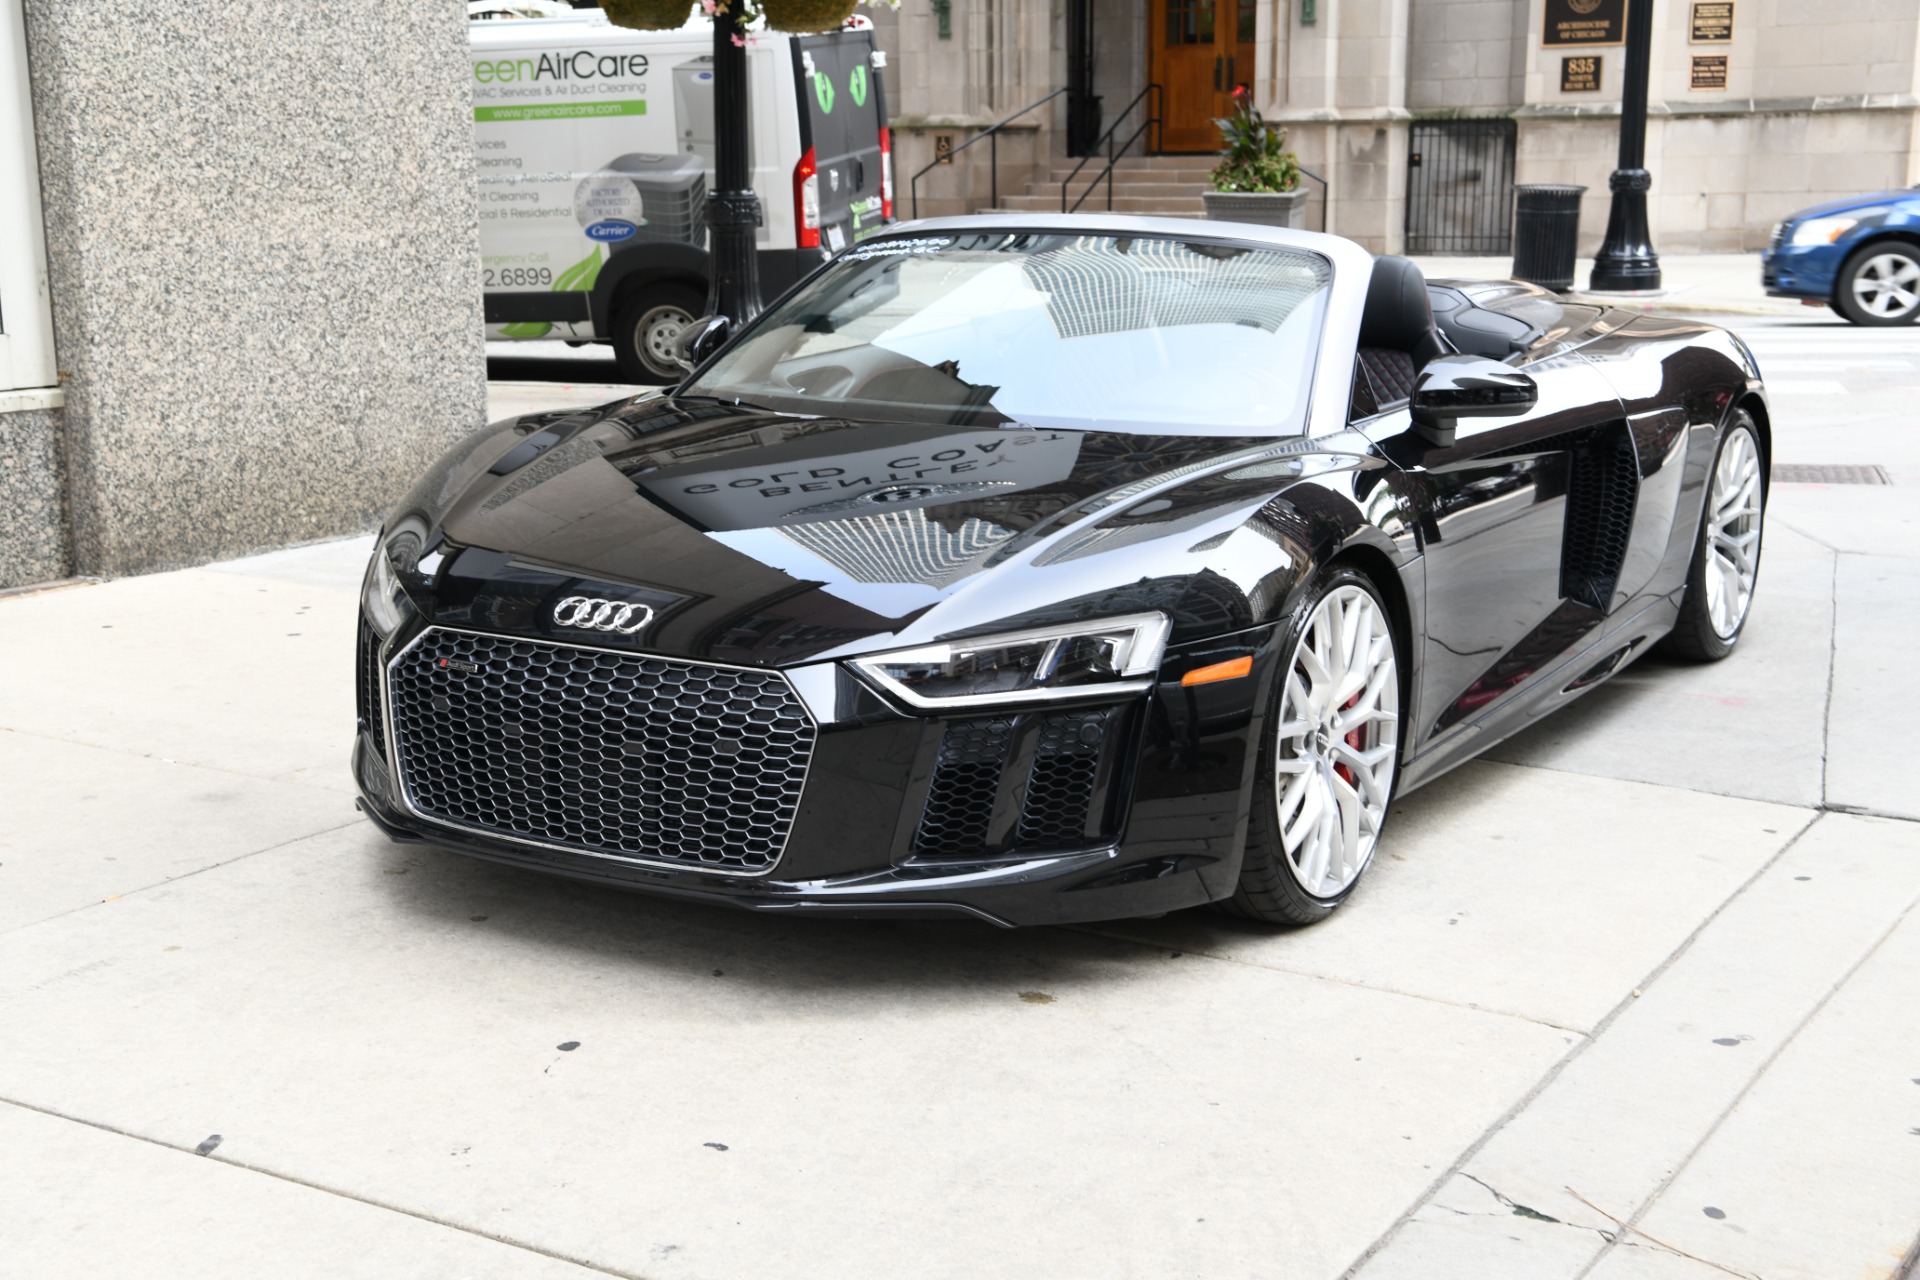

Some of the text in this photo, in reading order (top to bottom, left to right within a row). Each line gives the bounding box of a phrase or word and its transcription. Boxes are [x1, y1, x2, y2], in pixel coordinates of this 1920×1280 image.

[1571, 30, 1606, 39] CHICAGO
[472, 50, 649, 83] eenAirCare
[1568, 58, 1595, 74] 835
[500, 86, 542, 98] Services
[544, 86, 552, 96] &
[556, 85, 568, 95] Air
[571, 83, 595, 95] Duct
[599, 82, 647, 94] Cleaning
[492, 103, 622, 119] www.greenaircare.com
[475, 139, 507, 150] vices
[489, 190, 539, 203] Cleaning
[478, 206, 573, 219] cial & Residential
[594, 207, 624, 216] DEALER
[591, 225, 630, 236] Carrier
[482, 252, 549, 266] ergency Call
[482, 267, 553, 287] 2.6899
